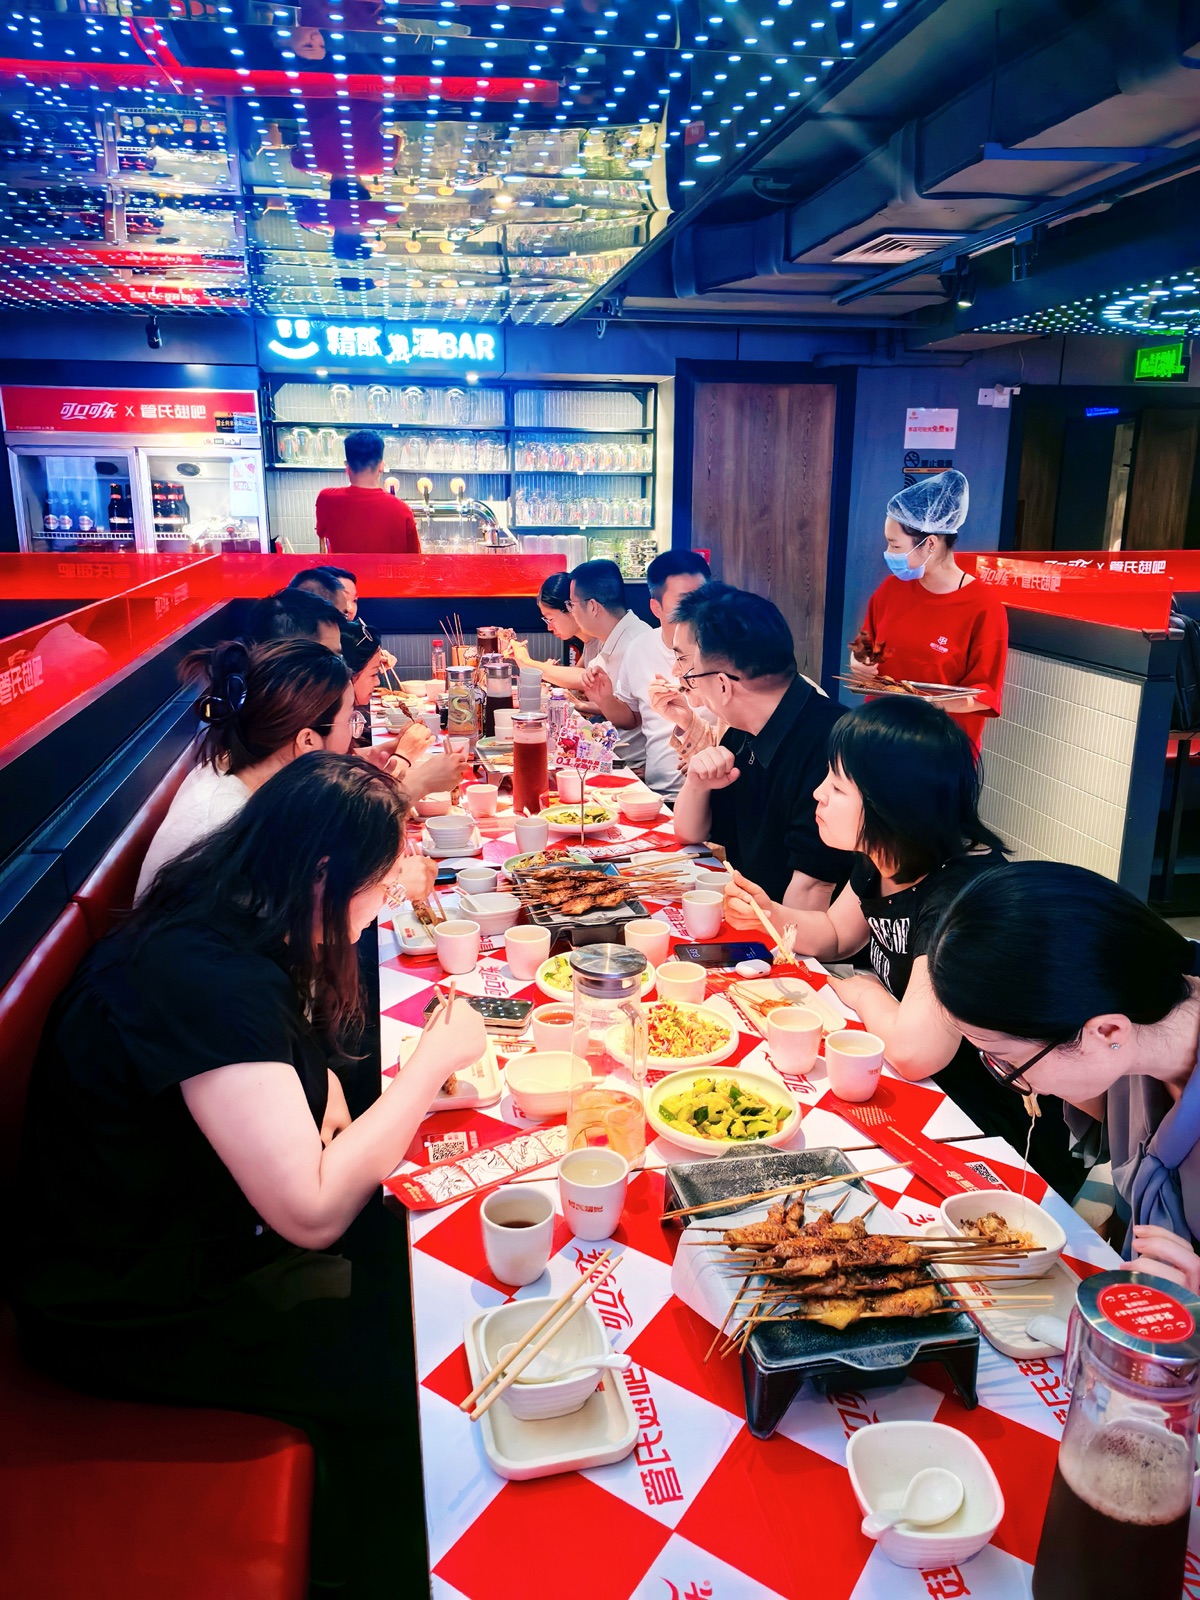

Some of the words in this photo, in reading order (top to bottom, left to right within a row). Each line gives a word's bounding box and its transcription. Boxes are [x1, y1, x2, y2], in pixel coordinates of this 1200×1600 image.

[60, 401, 118, 420] 可口可乐
[140, 404, 206, 419] 管氏翅吧
[1109, 560, 1167, 575] 管氏翅吧
